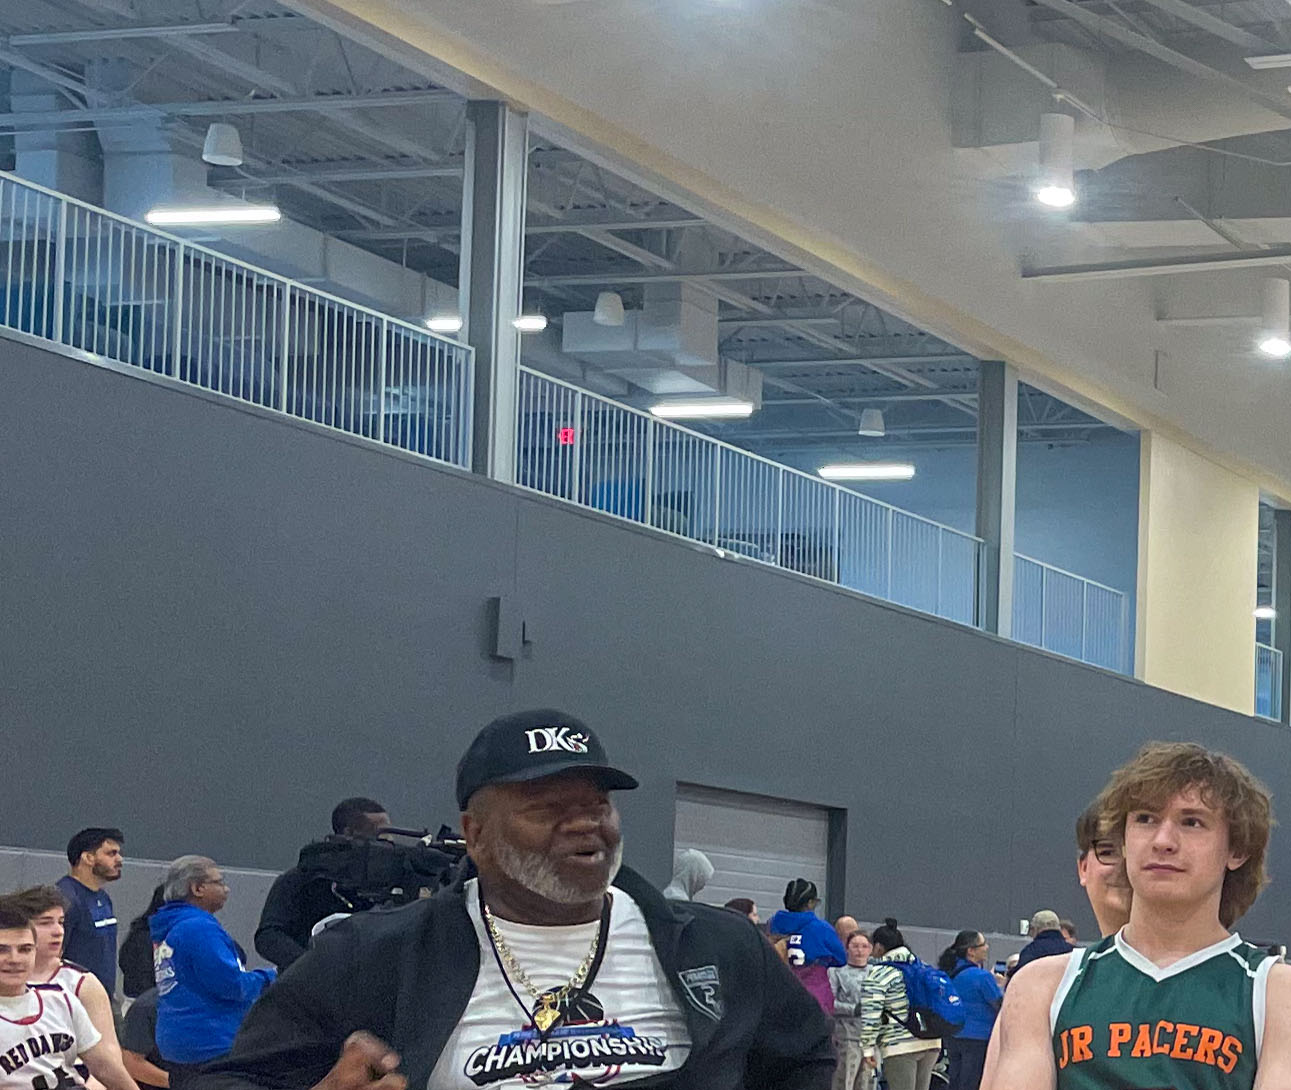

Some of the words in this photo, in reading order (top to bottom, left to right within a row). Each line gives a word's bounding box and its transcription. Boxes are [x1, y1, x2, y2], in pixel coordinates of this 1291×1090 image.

[464, 1035, 668, 1079] CHAMPIONSHIP
[1058, 1023, 1095, 1071] JR
[1107, 1020, 1244, 1075] PACERS
